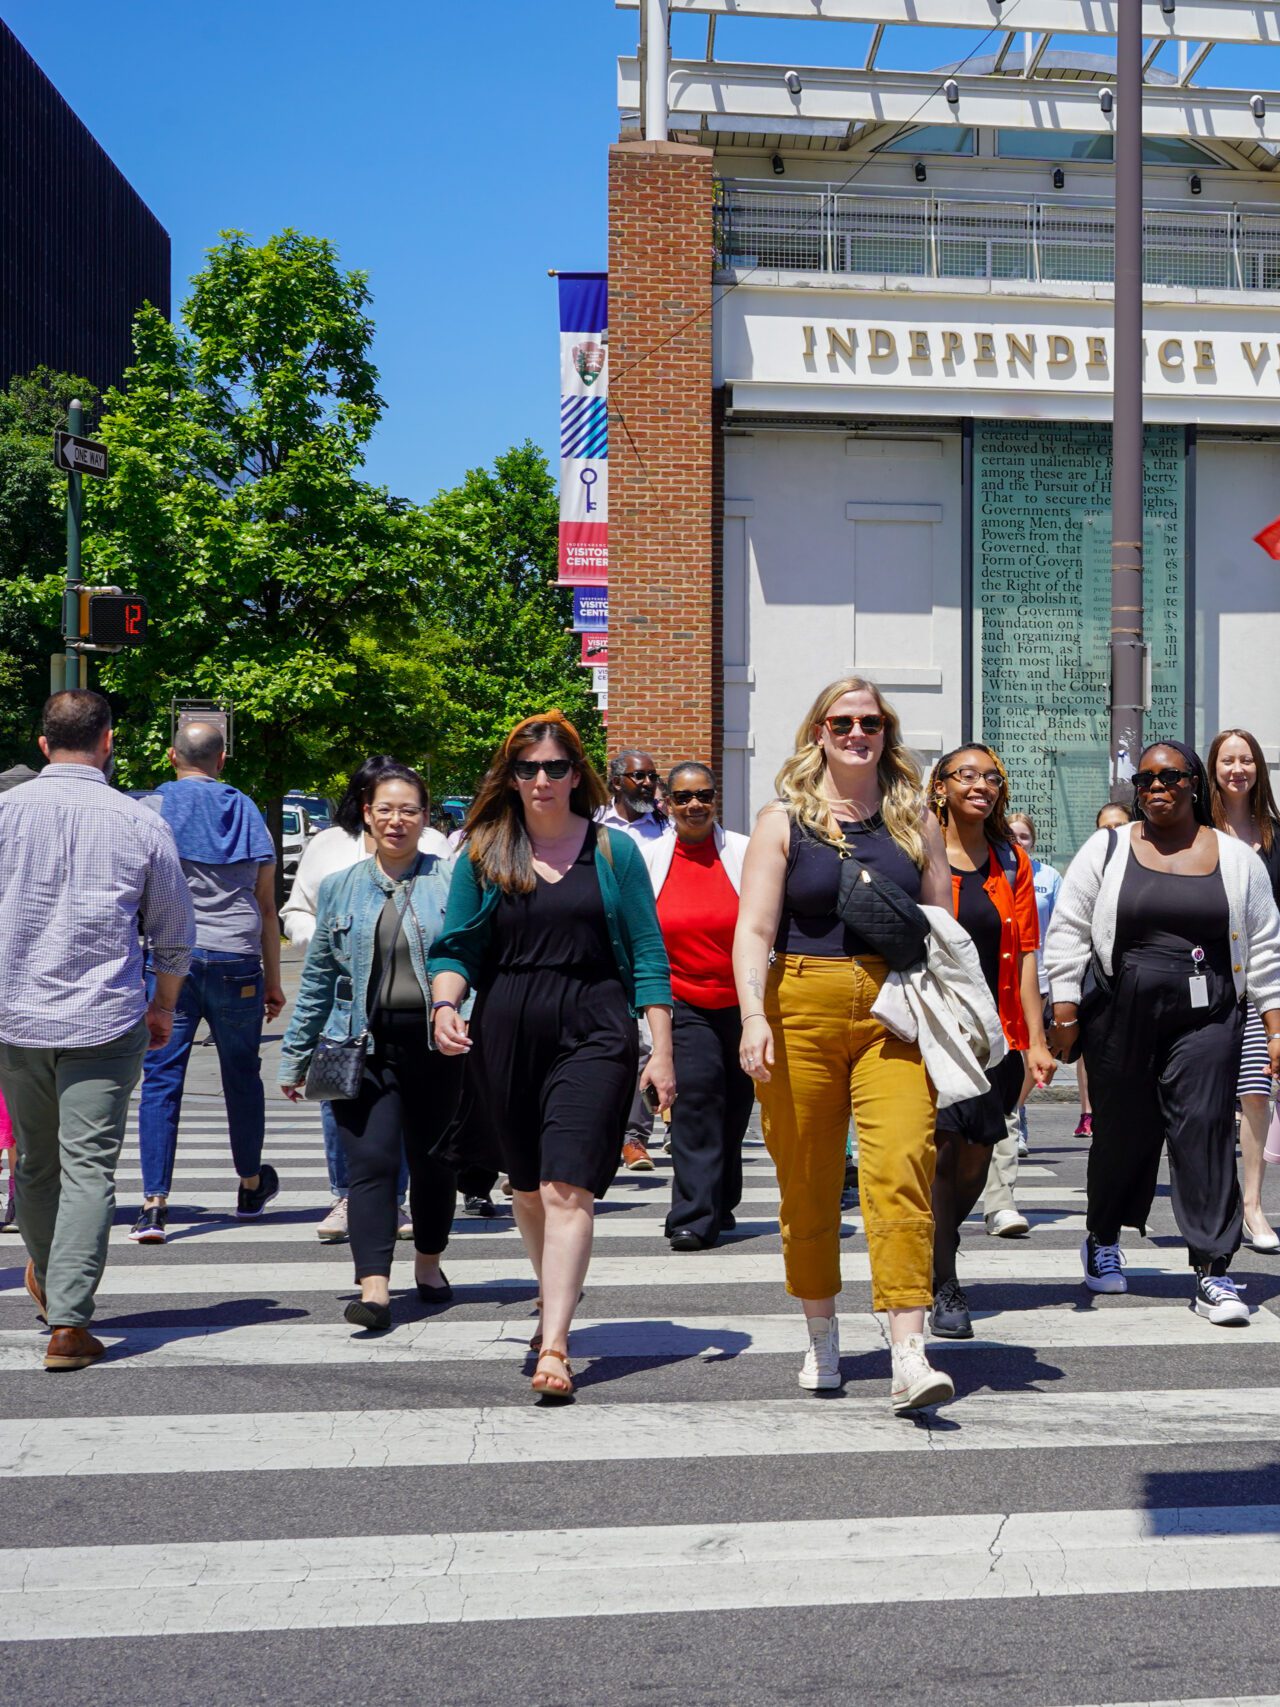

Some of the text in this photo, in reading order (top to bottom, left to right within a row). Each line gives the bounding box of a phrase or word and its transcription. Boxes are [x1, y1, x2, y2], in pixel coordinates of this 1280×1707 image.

[803, 325, 1218, 370] INDEPENDECE
[982, 430, 1178, 445] created are
[982, 442, 1178, 457] endowed by their with
[75, 448, 102, 467] ONE WAY
[982, 455, 1178, 470] certain unalienable that
[981, 467, 1087, 481] among these are
[982, 480, 1095, 492] and the Pursuit of
[983, 491, 1087, 504] That to secure
[982, 504, 1070, 516] Governments
[981, 518, 1061, 530] among Men,
[982, 530, 1082, 541] Powers from the
[567, 548, 608, 556] VISITOR
[1056, 543, 1081, 554] that
[567, 557, 608, 566] CENTER
[982, 554, 1031, 566] Form of
[982, 567, 1069, 579] destructive of
[982, 579, 1082, 592] the Right of the
[981, 592, 1082, 606] or to abolish it,
[982, 607, 1007, 616] new
[125, 605, 141, 634] 12
[982, 617, 1073, 629] Foundation on
[981, 630, 1081, 644] and organizing
[981, 642, 1072, 656] such Form, as
[981, 656, 1050, 666] seem most
[981, 668, 1049, 679] Safety and
[989, 679, 1066, 691] When in the
[1035, 693, 1044, 703] it
[982, 704, 1178, 718] for one People to the
[982, 716, 1178, 730] Political Bands have
[982, 729, 1086, 741] connected them
